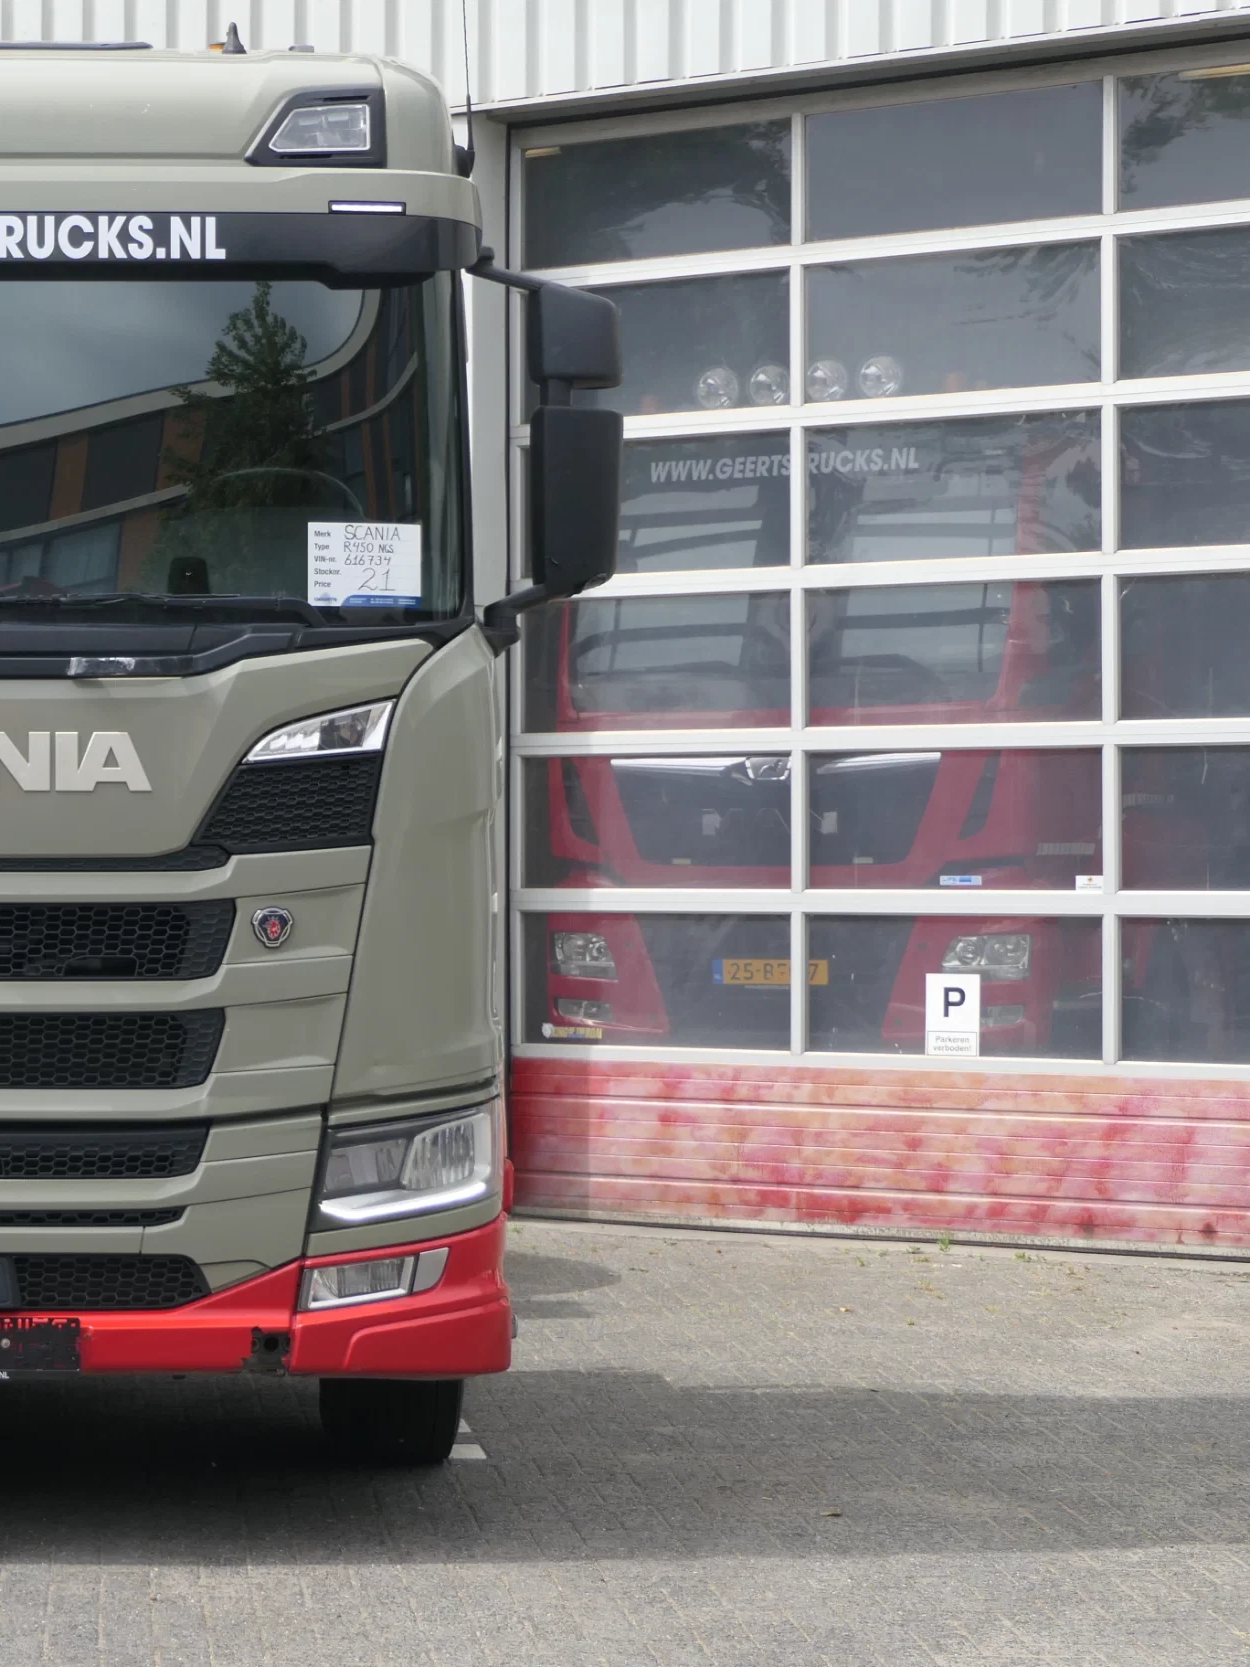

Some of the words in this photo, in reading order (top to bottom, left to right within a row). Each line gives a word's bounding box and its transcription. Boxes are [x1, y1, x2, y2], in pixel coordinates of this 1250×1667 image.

[651, 447, 919, 483] WWW.GEERTSRUCKS.NL
[313, 530, 331, 538] Merk
[344, 524, 401, 541] SCANIA
[313, 543, 330, 551] Type
[344, 553, 392, 566] 616734
[313, 580, 331, 588] Price
[358, 567, 396, 592] 21
[943, 986, 966, 1018] P
[935, 1035, 970, 1044] Parkeren
